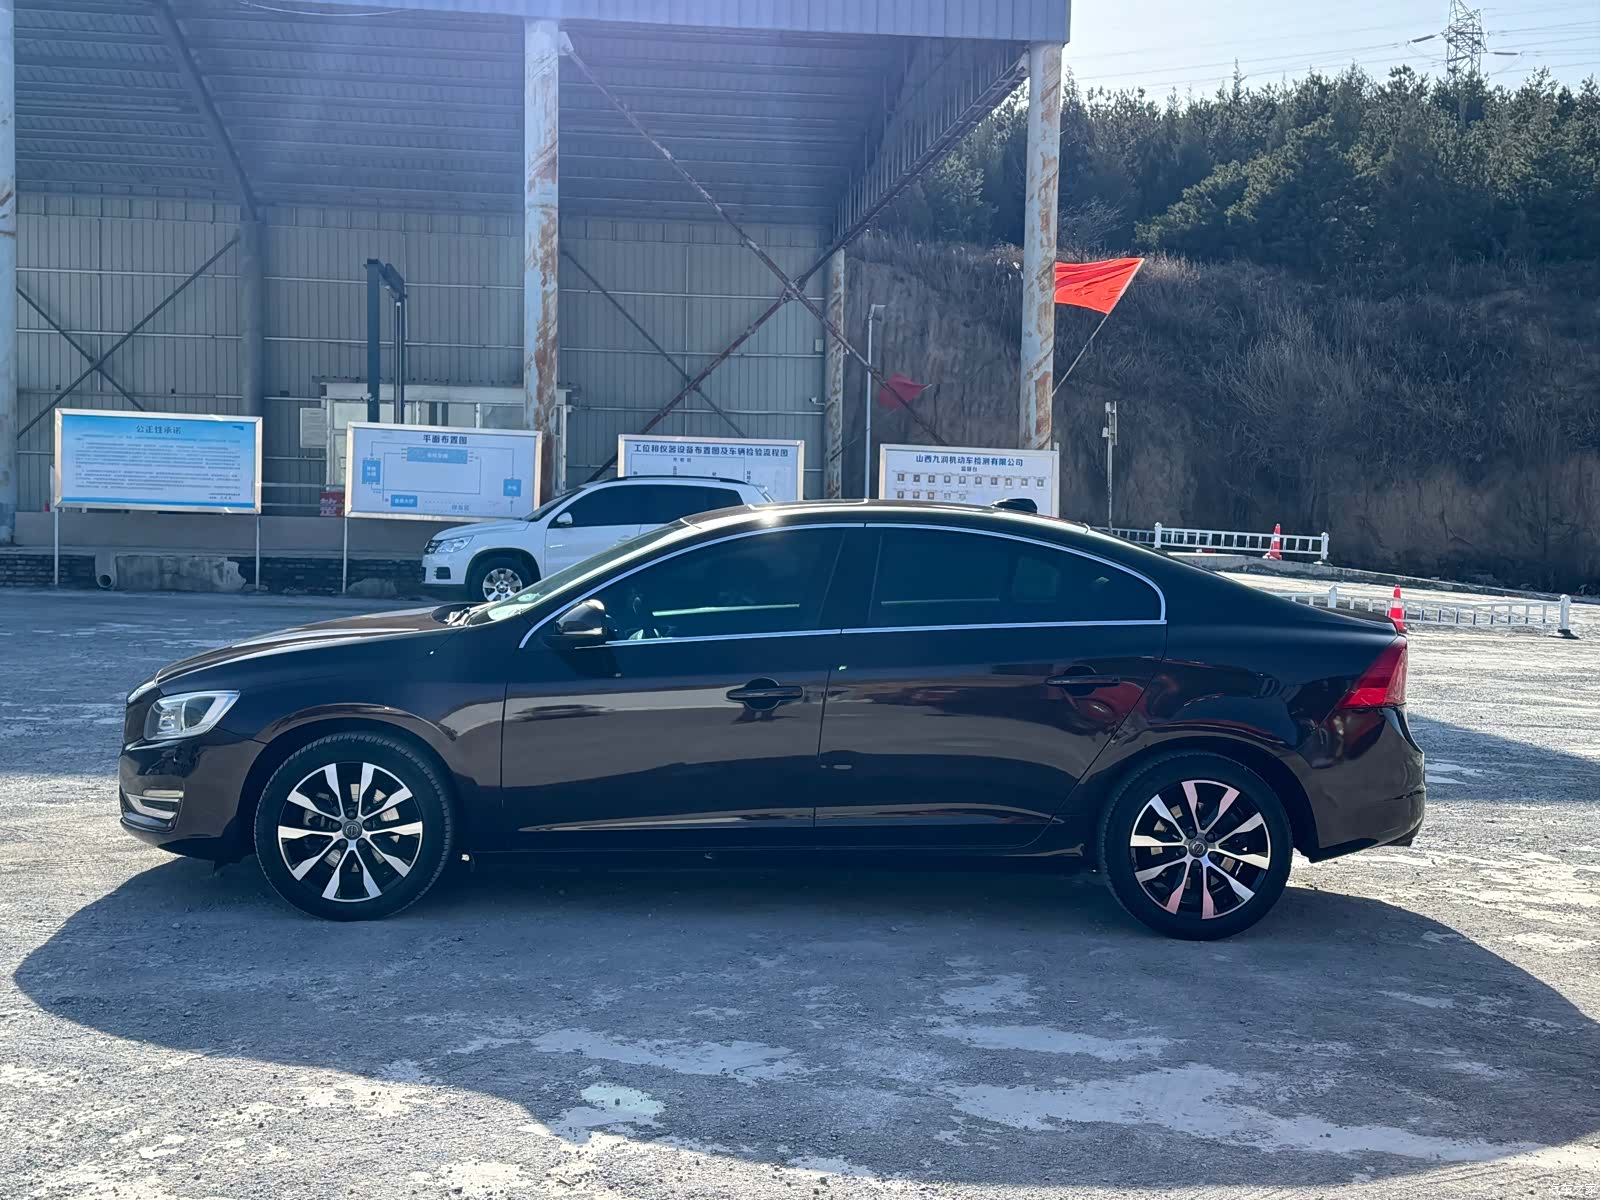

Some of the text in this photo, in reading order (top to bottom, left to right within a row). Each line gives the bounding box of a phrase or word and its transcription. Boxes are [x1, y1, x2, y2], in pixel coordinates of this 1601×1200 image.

[136, 424, 182, 435] 公正性承诺
[422, 434, 468, 445] 平面布置图
[634, 444, 789, 457] 工位和仪器设备布置图及车辆检验流程图
[915, 454, 1024, 467] 山西九润机动车检测有限公司
